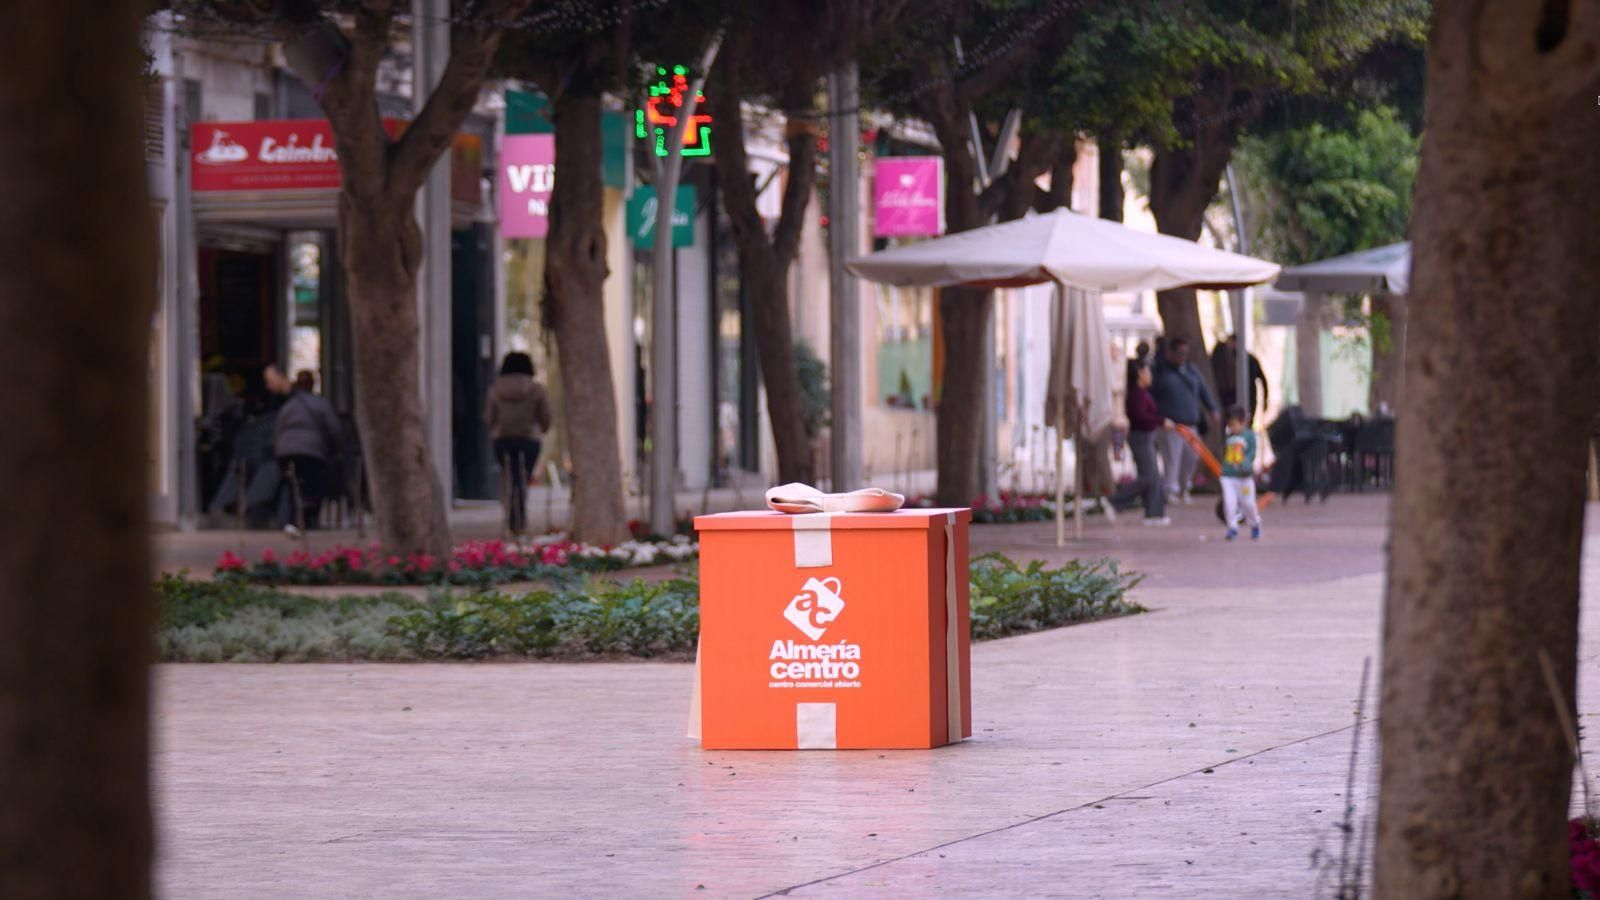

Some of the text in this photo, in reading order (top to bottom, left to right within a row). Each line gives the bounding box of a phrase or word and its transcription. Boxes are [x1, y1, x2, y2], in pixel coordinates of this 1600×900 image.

[769, 639, 861, 660] Almería
[769, 656, 860, 679] centro
[795, 680, 832, 688] comercial
[834, 680, 862, 688] abierto
